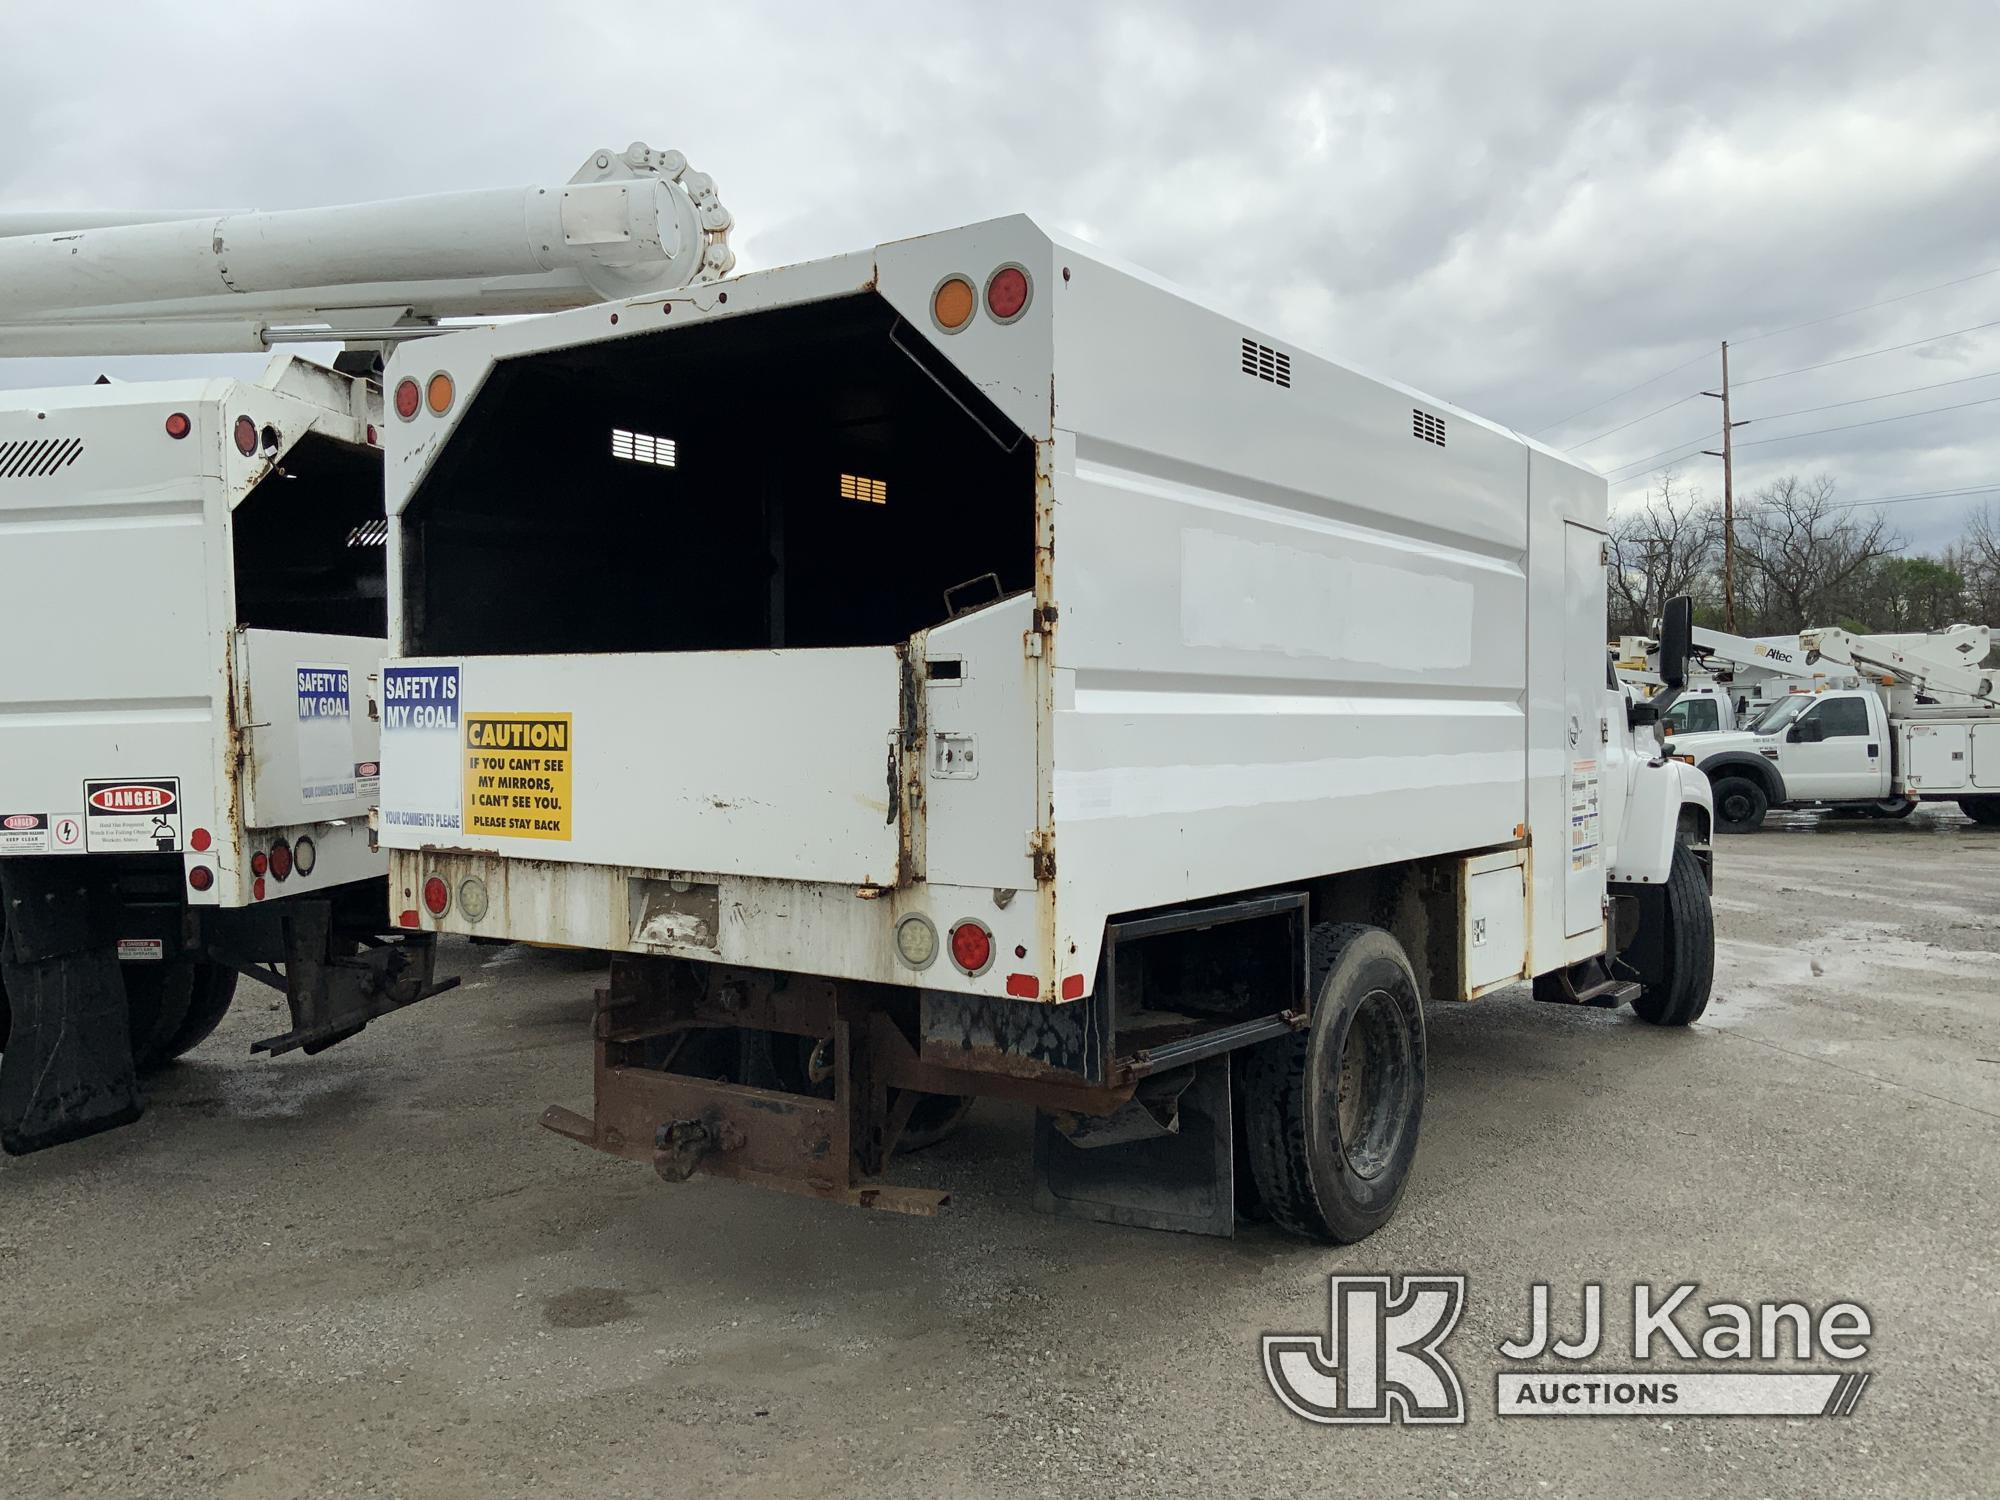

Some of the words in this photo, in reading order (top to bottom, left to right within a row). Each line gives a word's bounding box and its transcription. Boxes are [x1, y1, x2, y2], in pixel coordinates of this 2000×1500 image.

[1765, 648, 1793, 663] Altec
[299, 673, 335, 692] SAFETY
[338, 674, 348, 692] IS
[386, 676, 438, 699] SAFETY
[443, 676, 456, 699] IS
[300, 697, 316, 716] MY
[320, 697, 349, 716] GOAL
[387, 706, 410, 728] MY
[413, 706, 456, 728] GOAL
[469, 723, 565, 748] CAUTION
[470, 758, 479, 769] IF
[482, 758, 505, 770] YOU
[509, 759, 540, 771] CAN'T
[544, 760, 563, 772] SEE
[479, 776, 495, 788] MY
[498, 777, 554, 793] MIRRORS,
[104, 790, 161, 806] DANGER
[472, 794, 475, 805] I
[479, 794, 509, 807] CAN'T
[512, 796, 531, 808] SEE
[534, 797, 562, 810] YOU.
[385, 811, 400, 824] YOUR
[402, 812, 434, 827] COMMENTS
[436, 814, 460, 828] PLEASE
[474, 816, 506, 828] PLEASE
[509, 818, 531, 829] STAY
[535, 820, 560, 831] BACK
